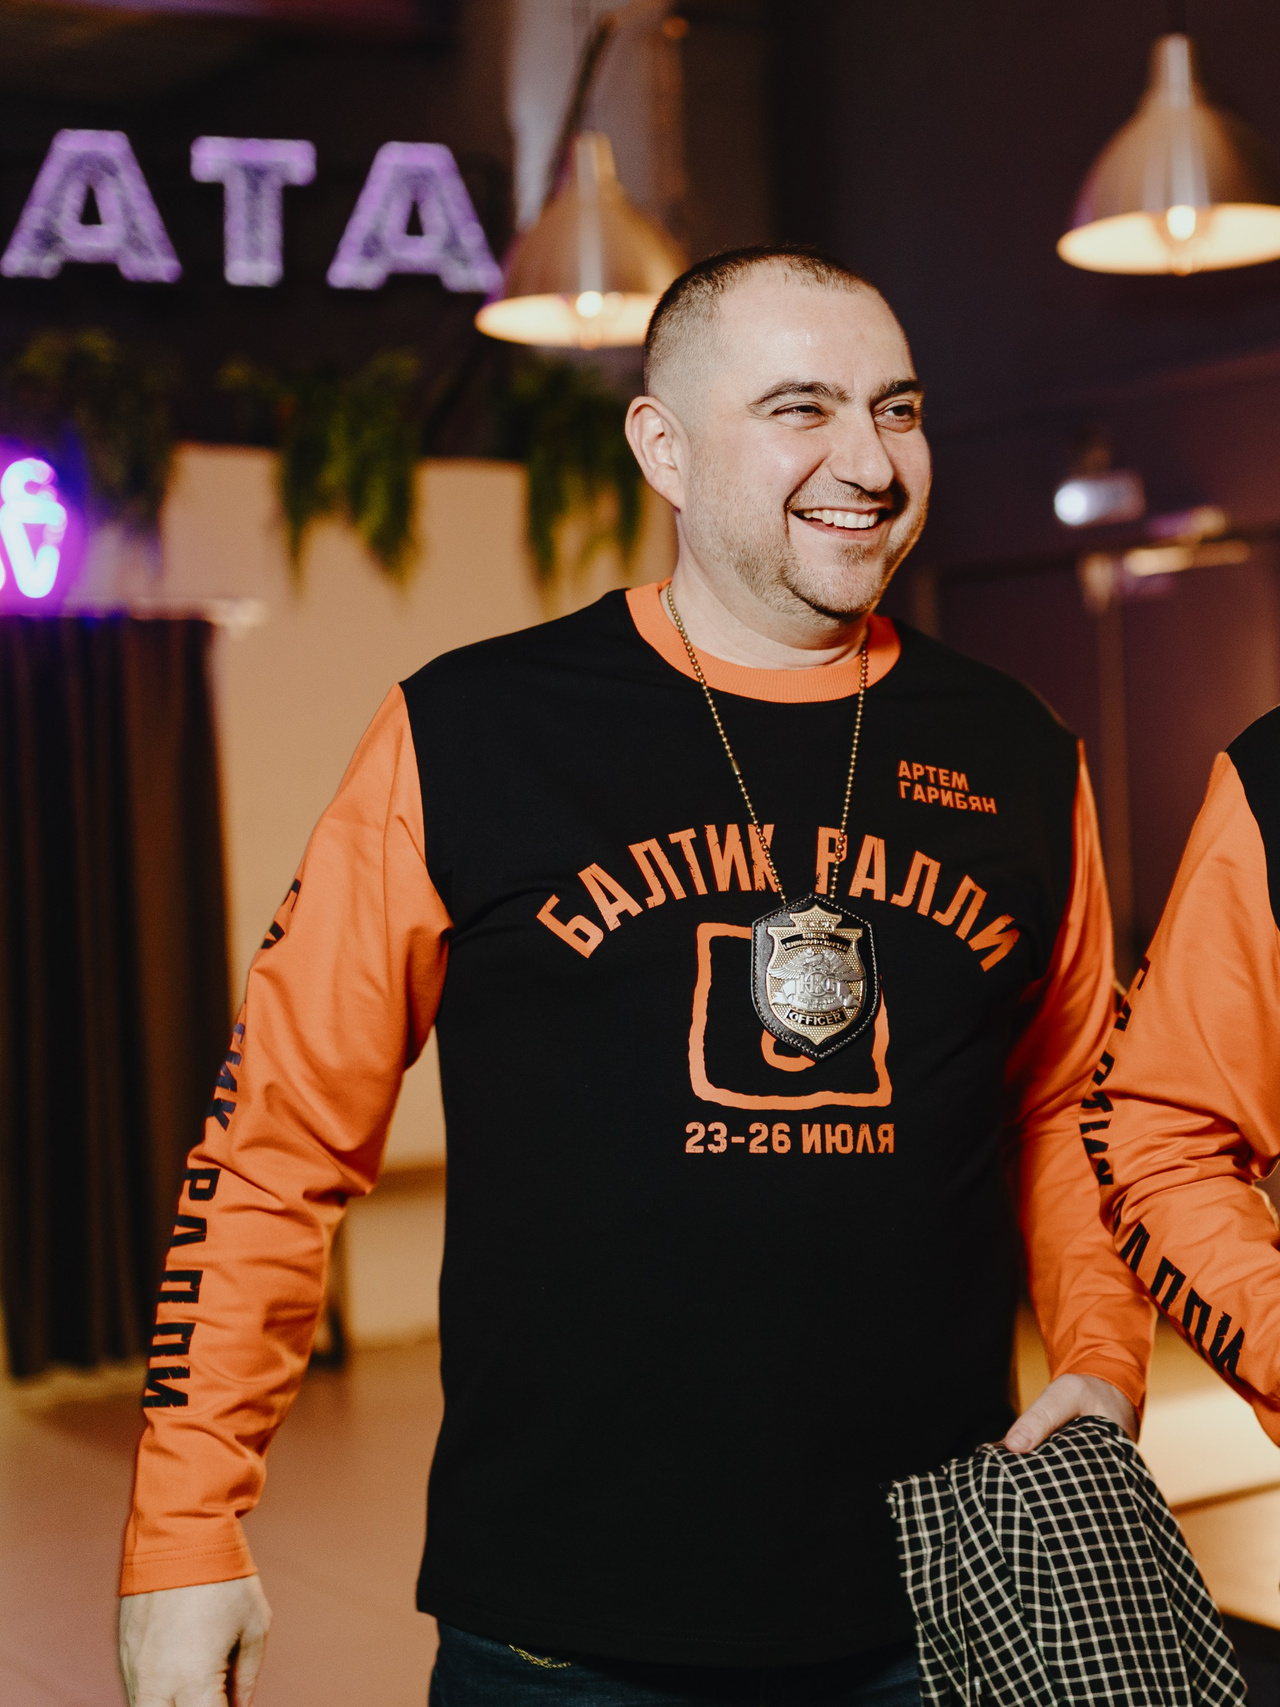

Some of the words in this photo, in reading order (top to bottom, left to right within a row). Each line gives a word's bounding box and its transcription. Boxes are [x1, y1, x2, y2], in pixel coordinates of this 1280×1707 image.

[898, 760, 969, 792] АРТЕМ
[899, 780, 998, 815] ГАРИБЯН
[536, 823, 781, 960] БАЛТИК
[814, 826, 1021, 973] РАЛЛИ
[789, 1012, 843, 1026] OFFICER
[685, 1122, 792, 1154] 23-26
[802, 1123, 895, 1154] ИЮЛЯ
